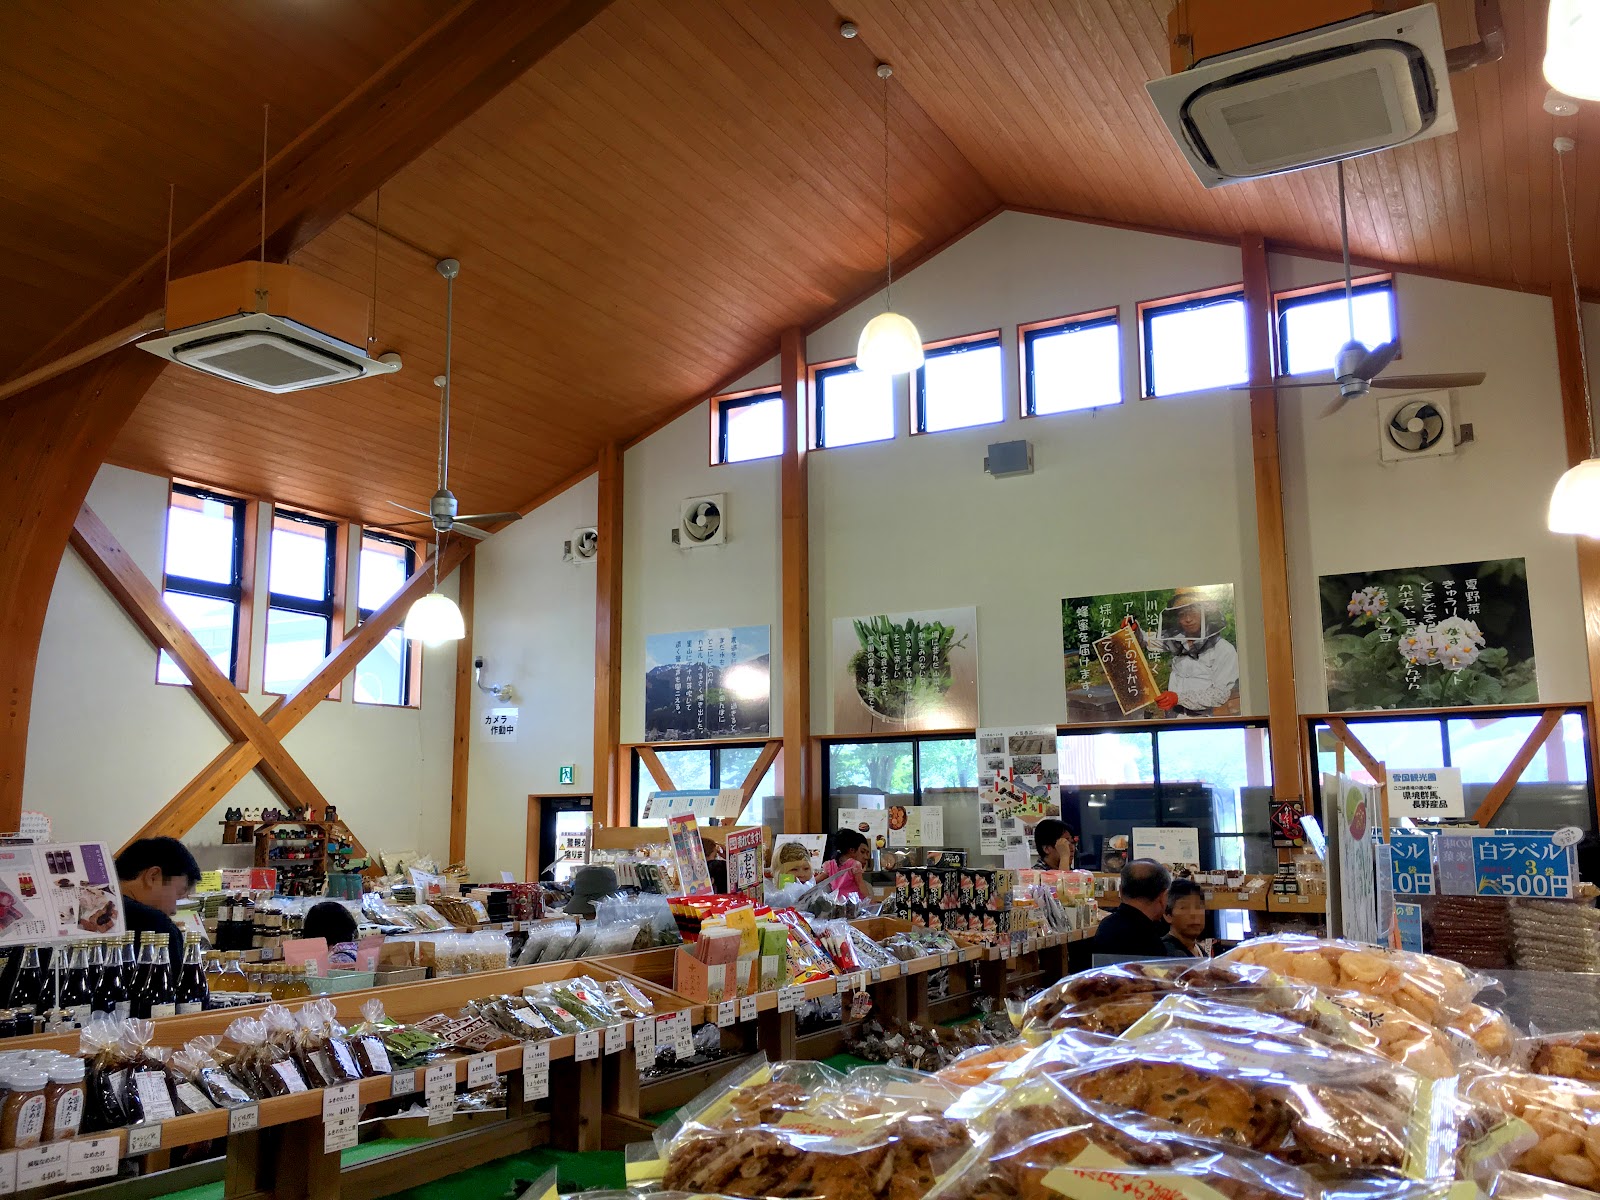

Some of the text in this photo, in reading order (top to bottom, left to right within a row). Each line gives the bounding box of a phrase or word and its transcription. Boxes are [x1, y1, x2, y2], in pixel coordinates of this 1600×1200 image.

[1465, 578, 1481, 615] 夏野菜
[1099, 603, 1114, 663] 採れたての
[1376, 616, 1393, 643] ソラ豆
[1442, 580, 1464, 686] きゅうり なす トマト
[1076, 605, 1093, 698] 蜂蜜を届けます。
[1123, 601, 1139, 697] アカシアの花から
[485, 715, 508, 725] カメラ
[490, 725, 514, 735] 作動中
[1393, 773, 1437, 782] 雪国観光圏
[1412, 800, 1448, 809] 長野産品
[1478, 840, 1563, 861] 白ラベル
[1393, 860, 1400, 874] 1
[1525, 860, 1538, 875] 3
[1393, 872, 1433, 894] 0円
[1501, 874, 1569, 897] 500円
[64, 1096, 75, 1126] なめたけ
[84, 1150, 106, 1160] なめたけ
[40, 1170, 56, 1181] 440
[89, 1164, 105, 1175] 330
